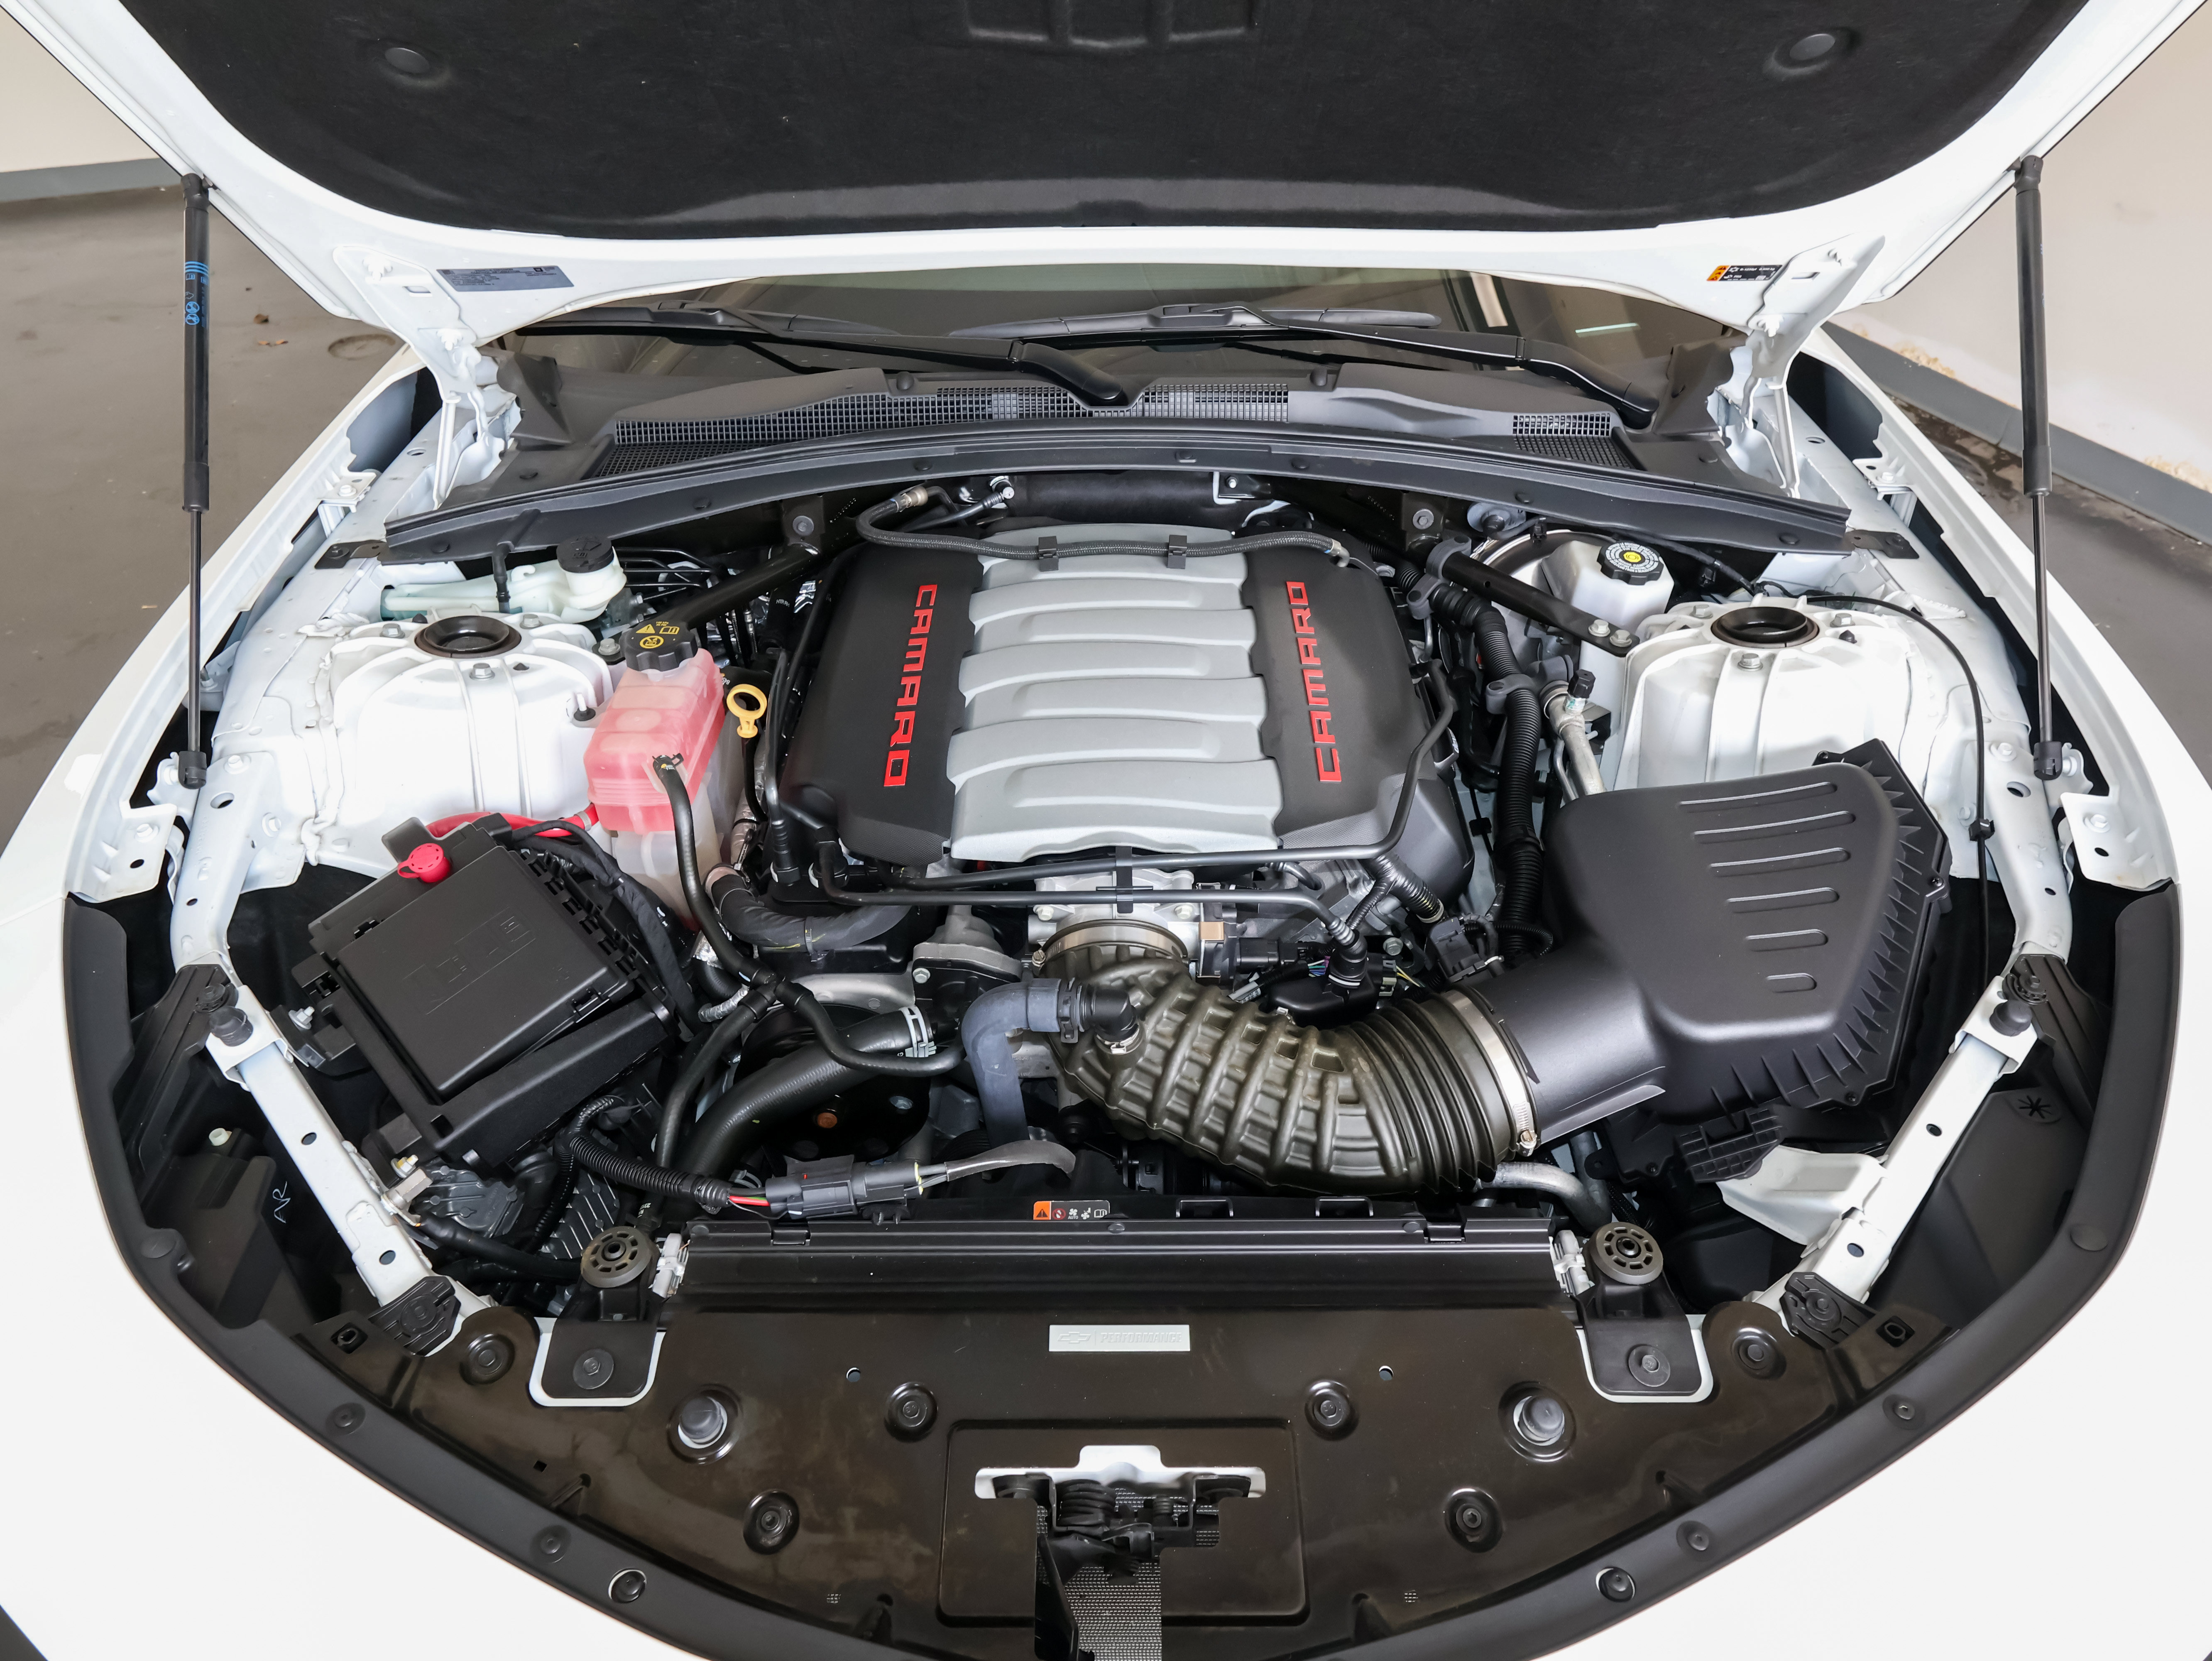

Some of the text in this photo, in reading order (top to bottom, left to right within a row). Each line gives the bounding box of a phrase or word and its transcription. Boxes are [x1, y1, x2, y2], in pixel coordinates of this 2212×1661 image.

[884, 585, 937, 787] CAMARO
[1286, 581, 1341, 782] CAMARO
[1100, 1332, 1182, 1343] PERFORMANCE
